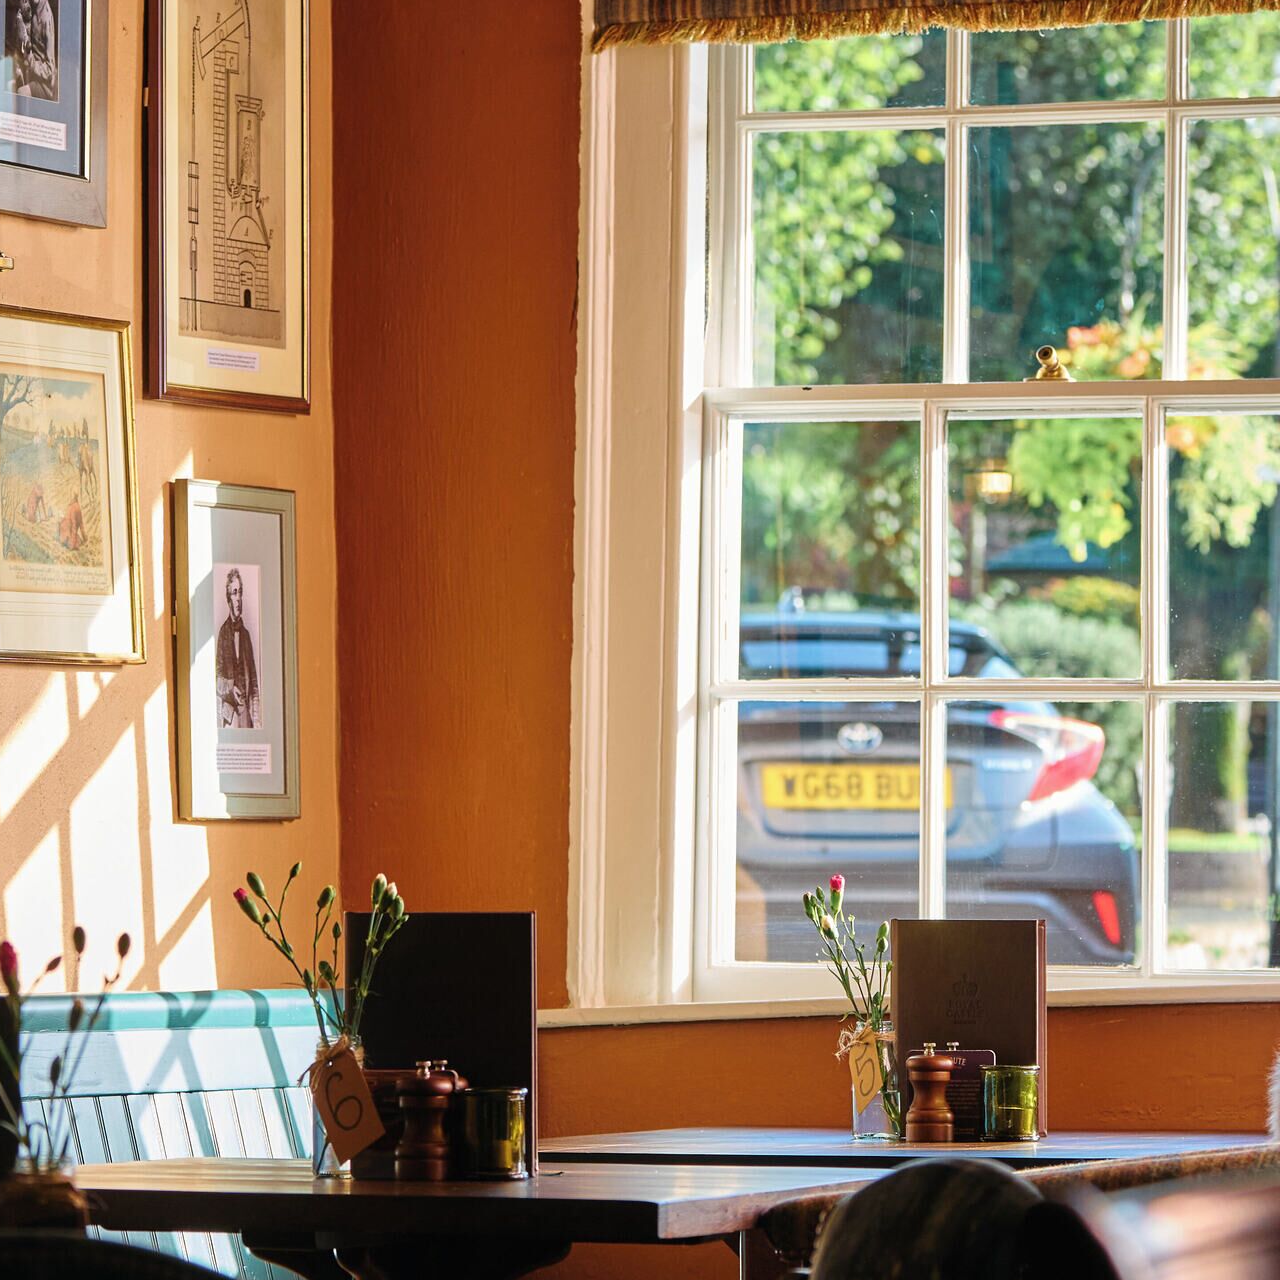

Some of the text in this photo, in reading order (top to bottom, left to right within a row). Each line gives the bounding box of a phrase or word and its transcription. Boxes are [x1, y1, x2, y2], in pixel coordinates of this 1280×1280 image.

[783, 772, 920, 800] WG68 BU
[854, 1045, 876, 1097] 5
[325, 1071, 365, 1132] 6
